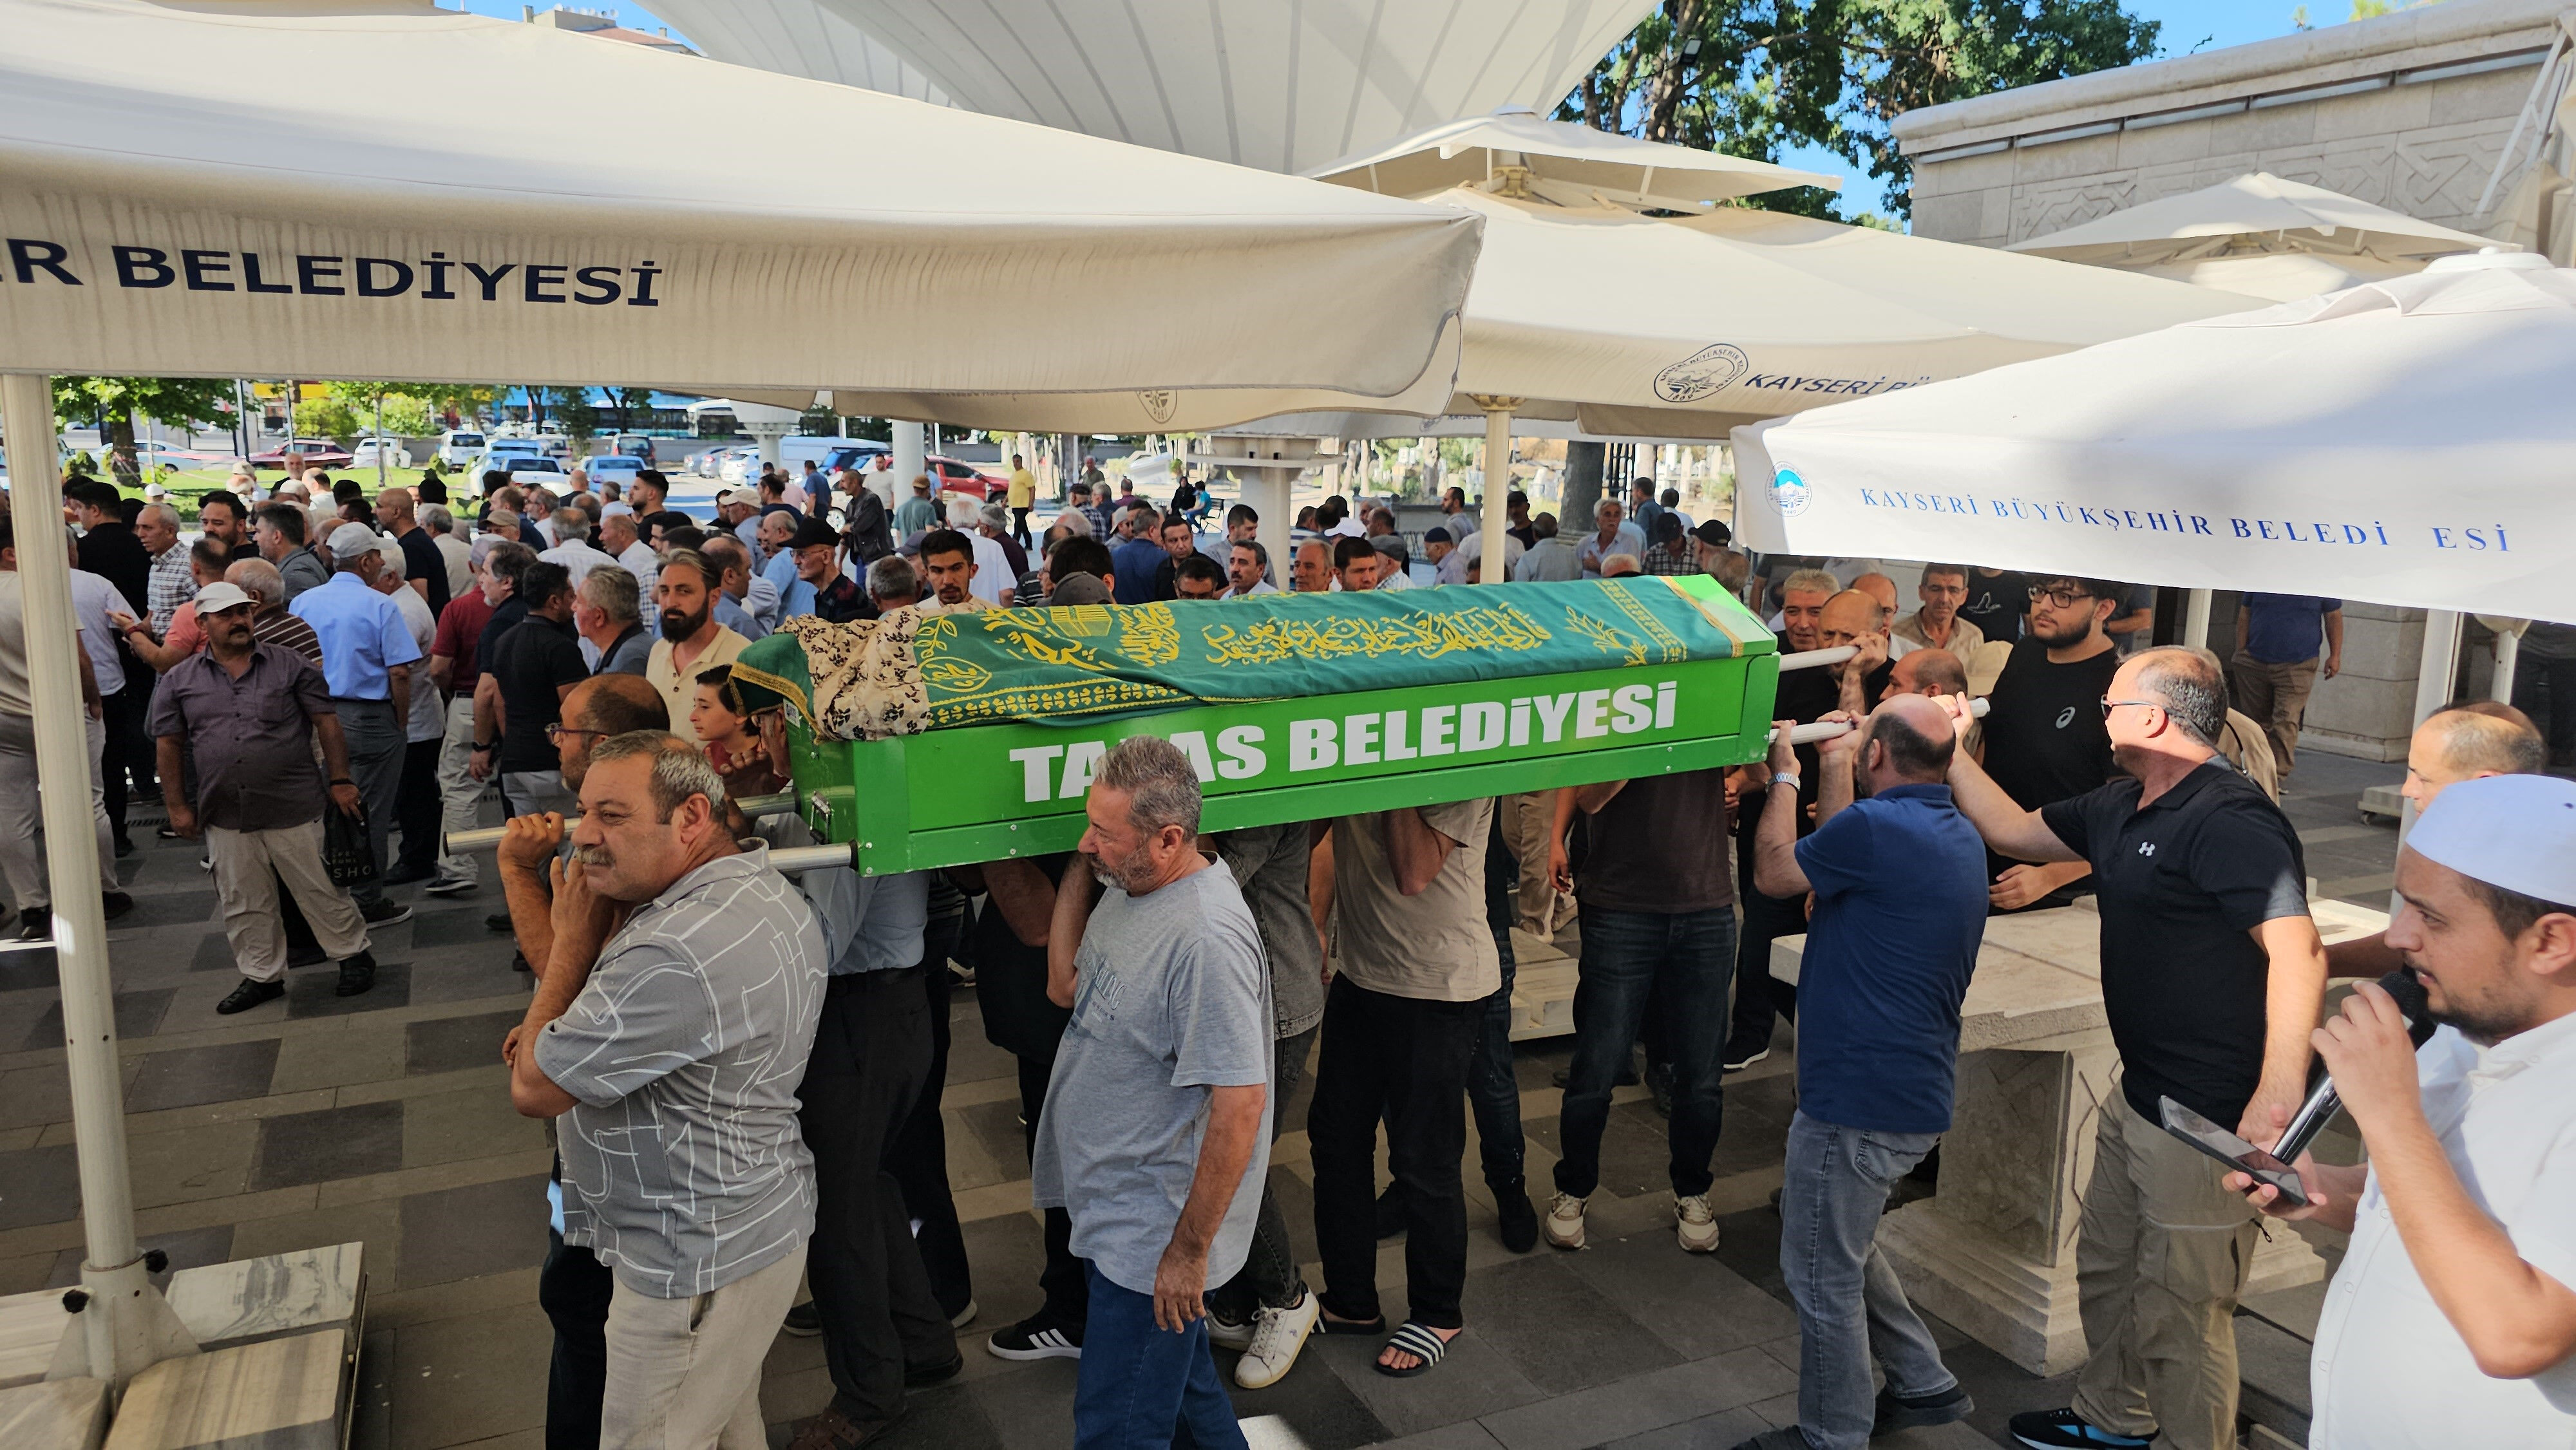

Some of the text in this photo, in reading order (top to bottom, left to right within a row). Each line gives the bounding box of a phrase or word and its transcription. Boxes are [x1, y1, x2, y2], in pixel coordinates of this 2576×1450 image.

[0, 238, 663, 306] R BELEDİYESİ
[1744, 373, 1887, 395] KAYSERİ
[1860, 487, 1980, 515] KAYSERİ
[1991, 498, 2214, 536] BÜYÜKŞEHİR
[1010, 681, 1677, 802] TAAS BELEDİYESİ
